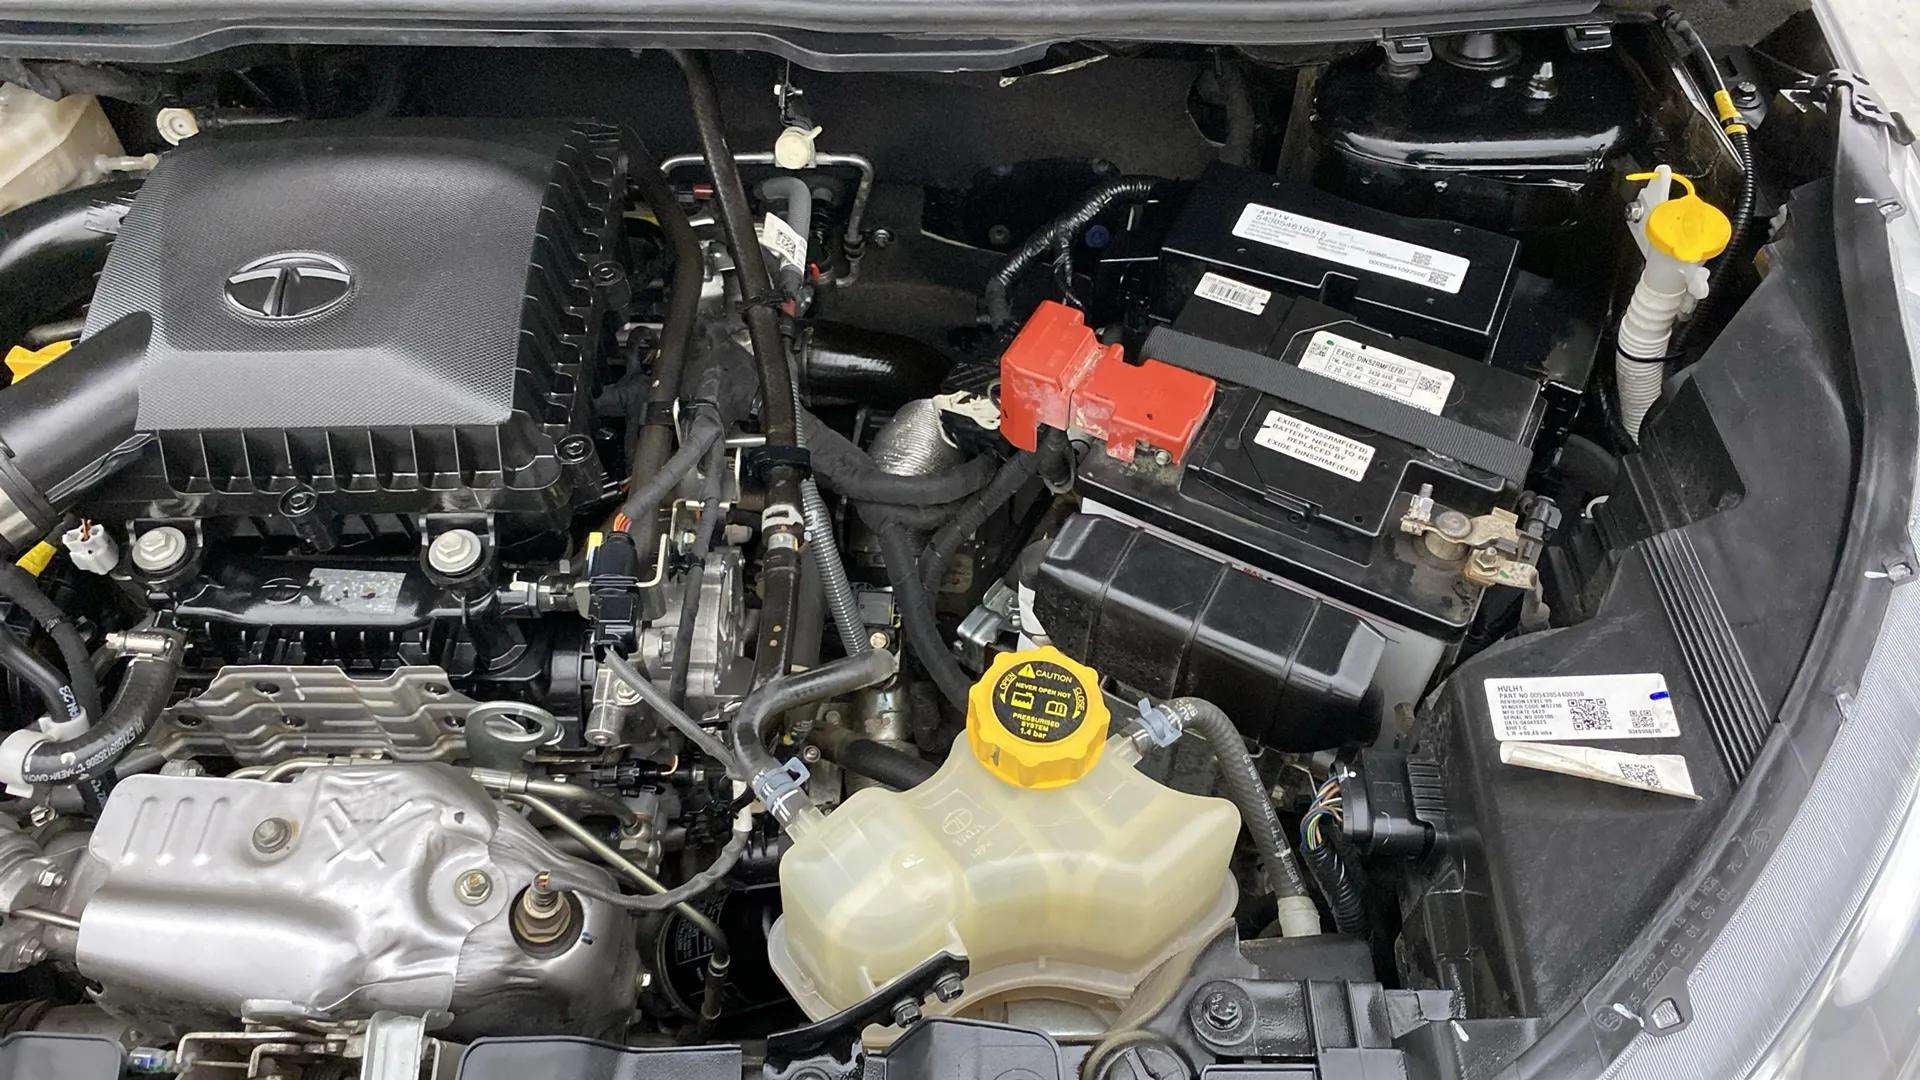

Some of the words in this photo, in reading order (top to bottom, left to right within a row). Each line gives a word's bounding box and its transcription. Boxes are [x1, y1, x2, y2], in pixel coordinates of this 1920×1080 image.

[1336, 349, 1355, 360] EXIDE
[1277, 416, 1302, 429] EXIDE
[1267, 438, 1292, 451] EXIDE
[1272, 423, 1309, 440] BATTERY
[1311, 437, 1340, 452] NEEDS
[1344, 449, 1355, 458] TO
[1358, 454, 1368, 463] BE
[1287, 436, 1331, 456] REPLACED
[1333, 453, 1346, 461] BY
[1000, 672, 1017, 690] OPEN
[1036, 669, 1073, 684] CAUTION
[1015, 682, 1038, 692] NEVER
[1038, 687, 1057, 697] OPEN
[1075, 687, 1085, 711] CLOSE
[1012, 712, 1060, 728] PRESSURISED
[1021, 721, 1049, 732] SYSTEM
[1020, 727, 1032, 736] 1.4
[1033, 729, 1047, 739] bar
